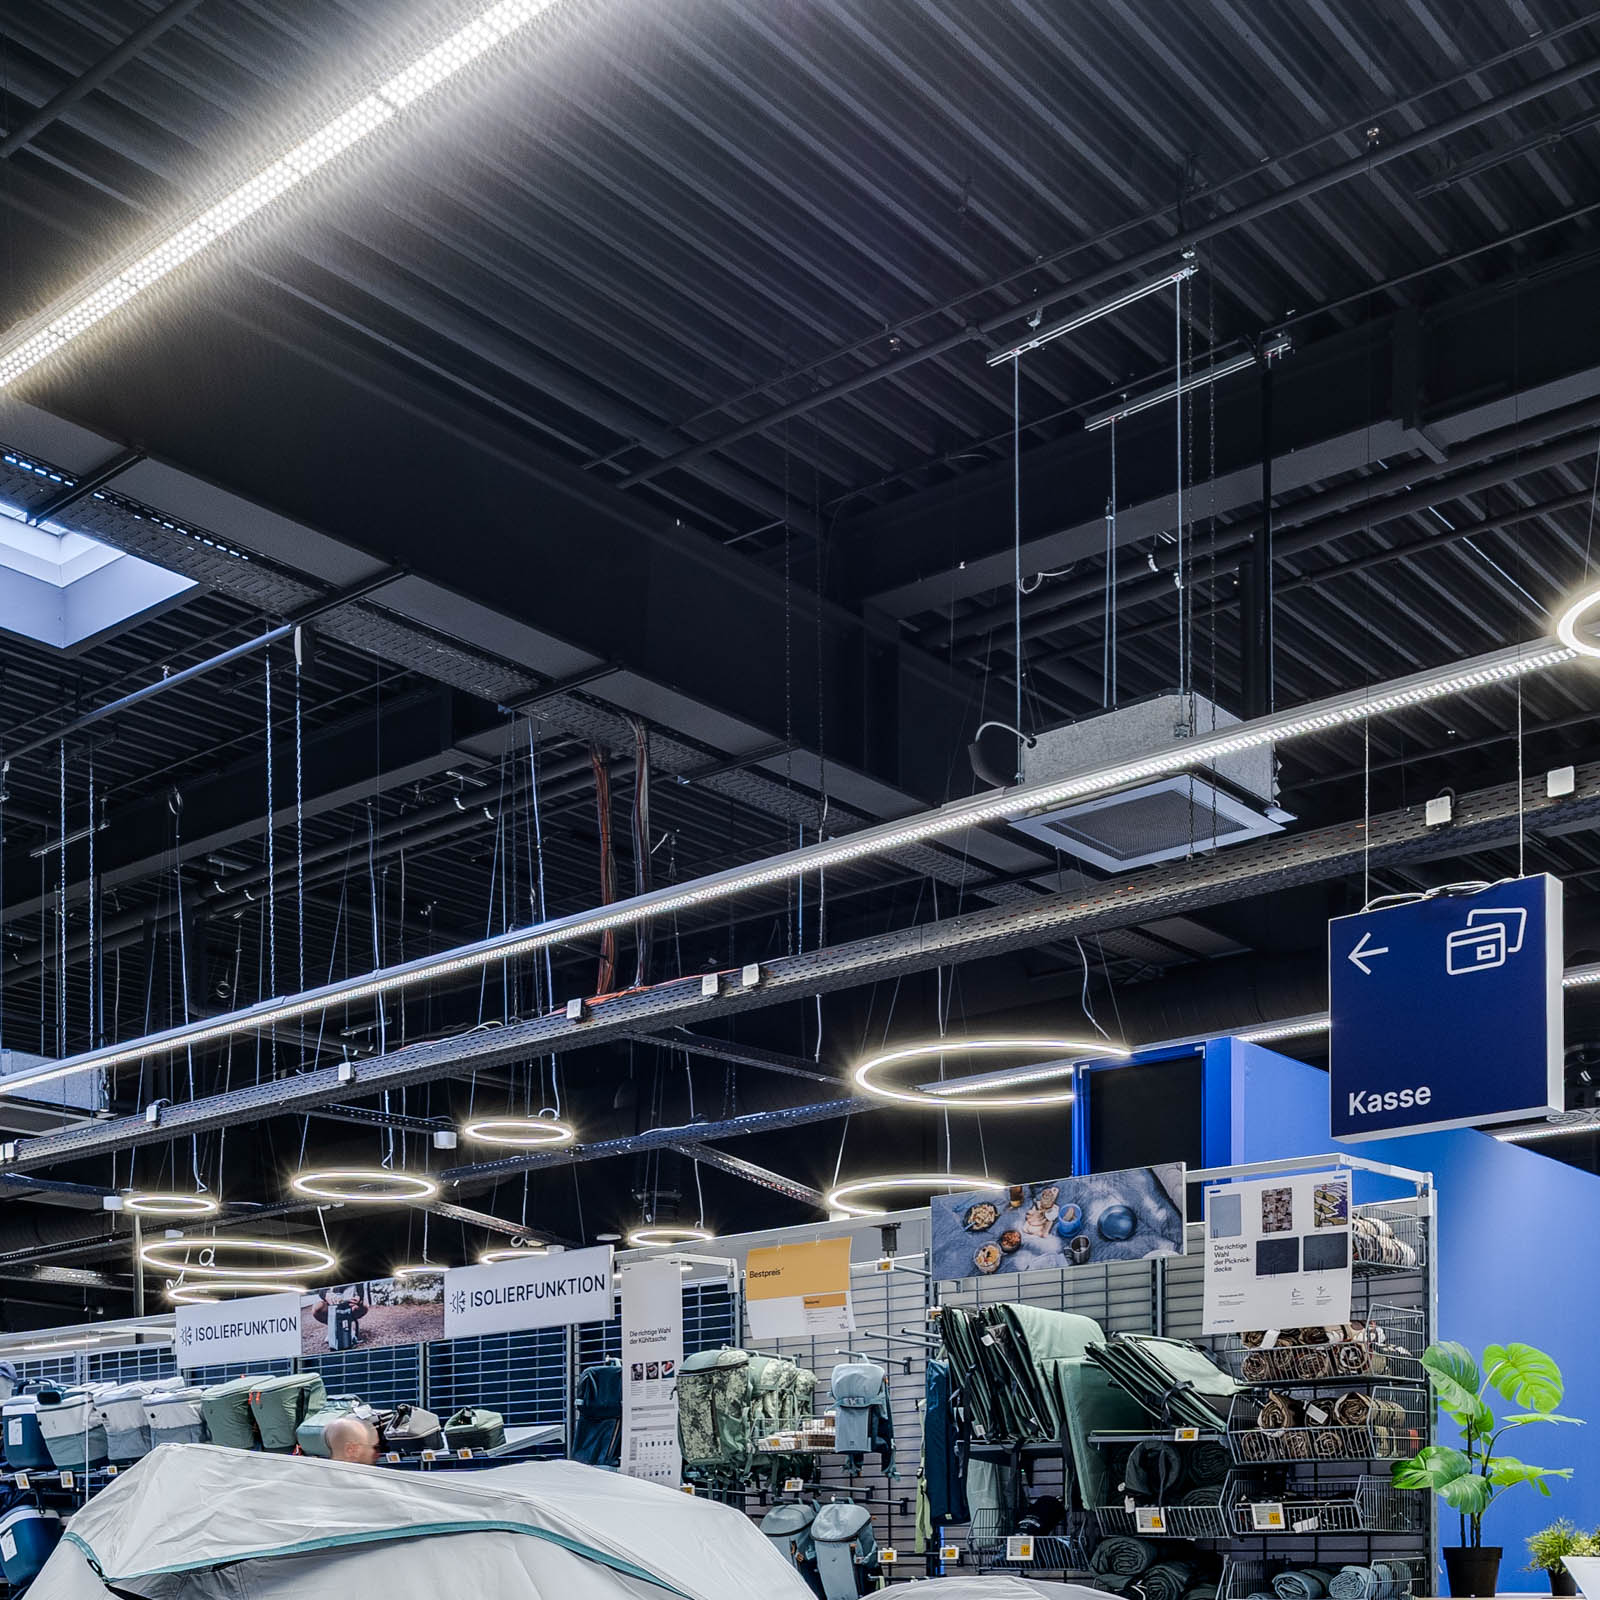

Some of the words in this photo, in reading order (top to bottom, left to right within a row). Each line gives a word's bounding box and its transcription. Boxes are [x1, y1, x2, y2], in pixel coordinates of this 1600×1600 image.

[1348, 1086, 1432, 1116] Kasse
[470, 1273, 606, 1308] ISOLIERFUNKTION
[195, 1316, 298, 1342] ISOLIERFUNKTION
